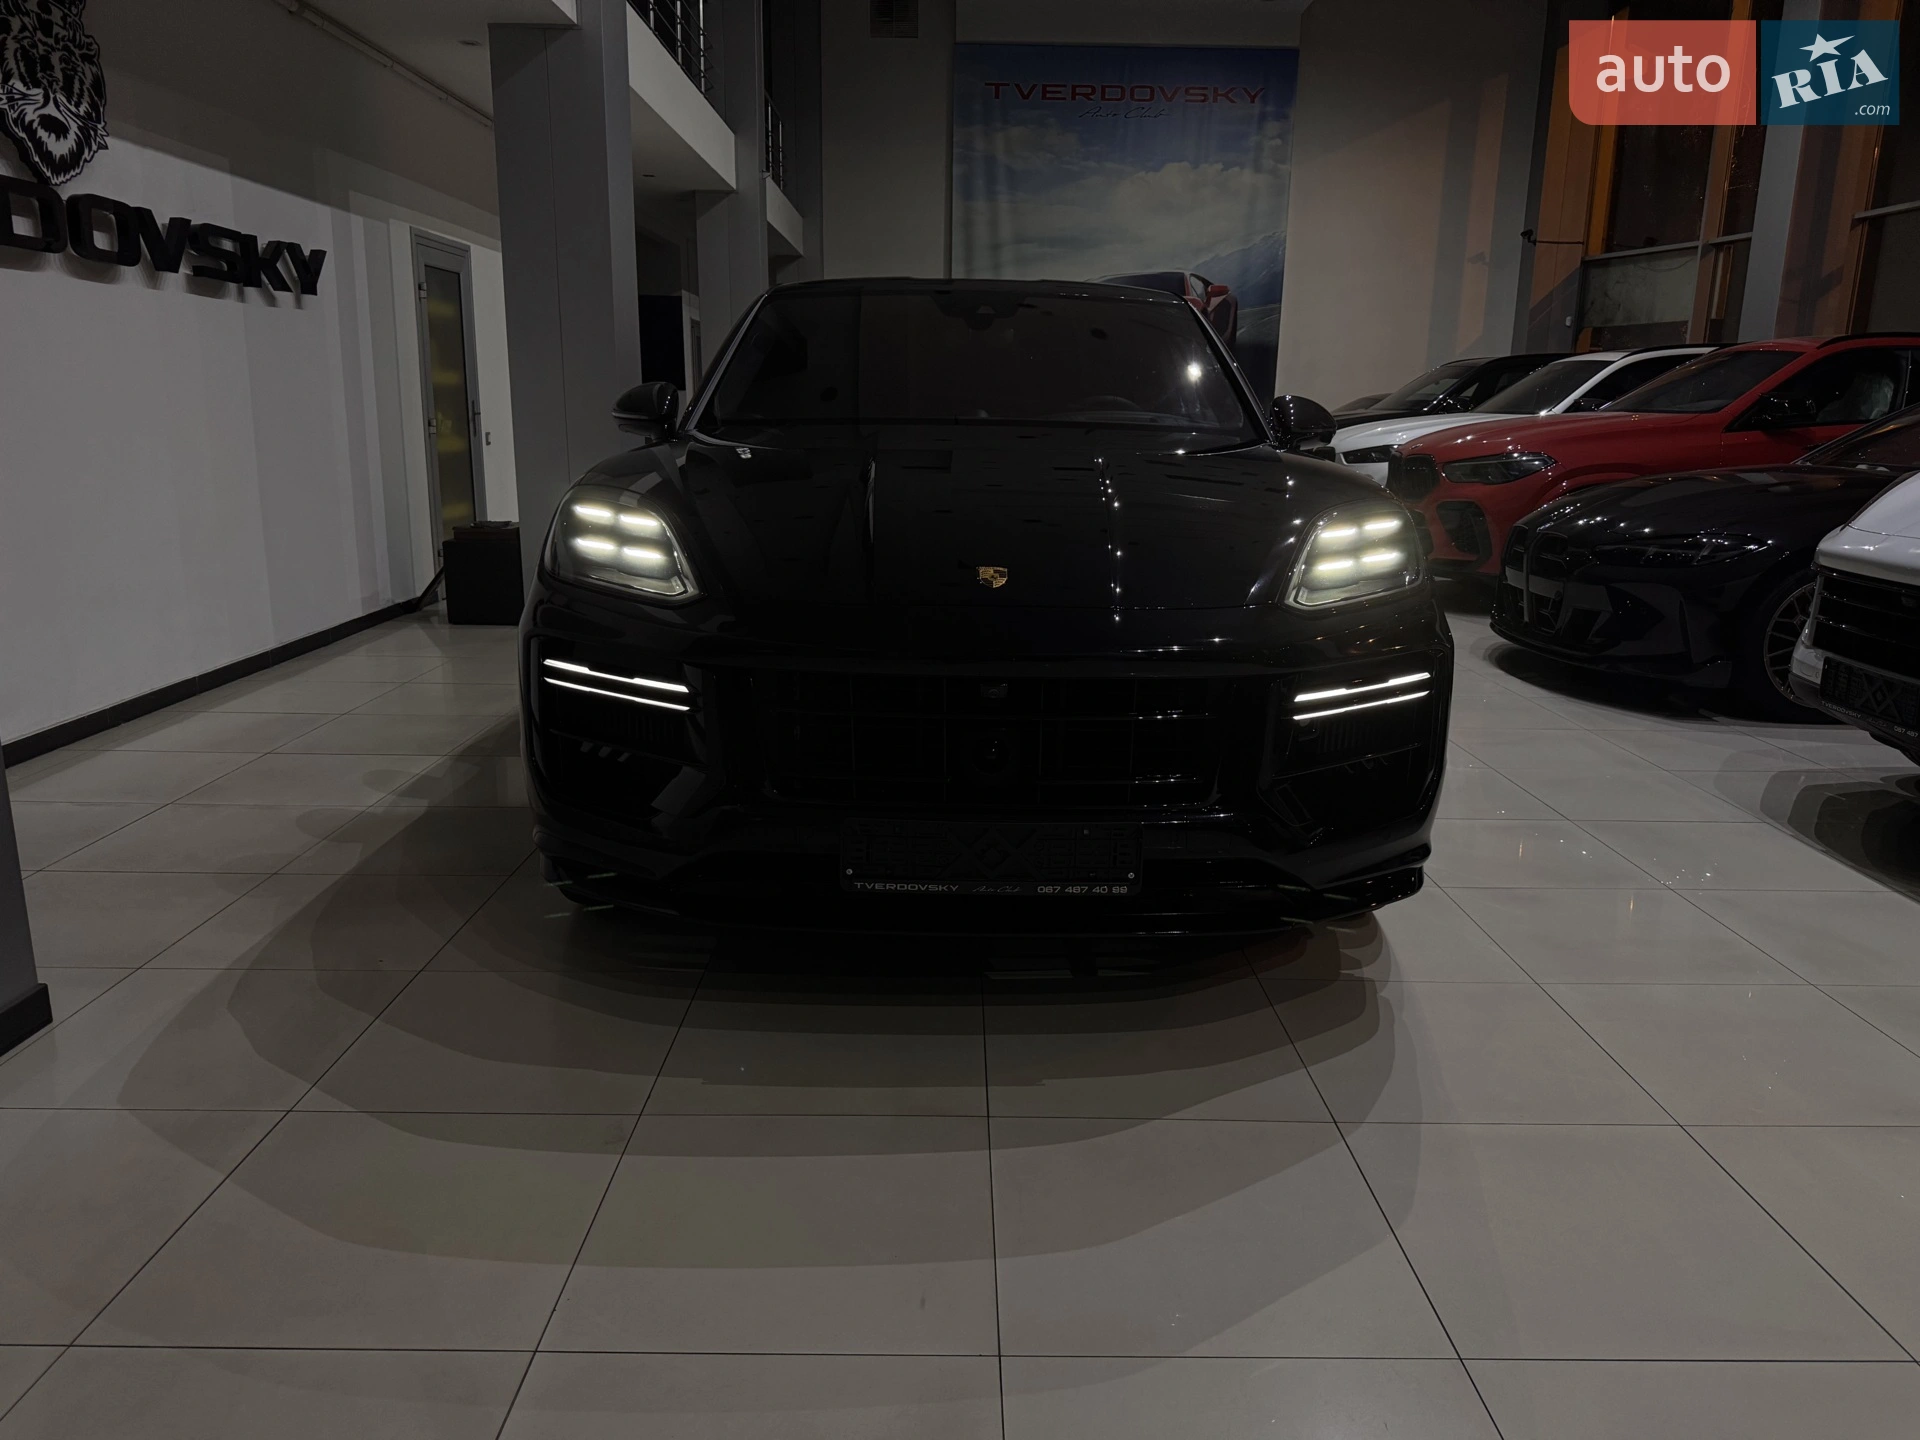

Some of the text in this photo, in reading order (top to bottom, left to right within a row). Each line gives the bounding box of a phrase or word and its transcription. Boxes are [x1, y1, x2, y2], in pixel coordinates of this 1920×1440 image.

[984, 82, 1266, 104] TVERDOVSKY
[1078, 105, 1171, 119] Auto Club
[853, 882, 960, 892] TVERDOVSKY
[1037, 885, 1061, 894] 067
[1065, 885, 1089, 894] 487
[1092, 885, 1109, 894] 40
